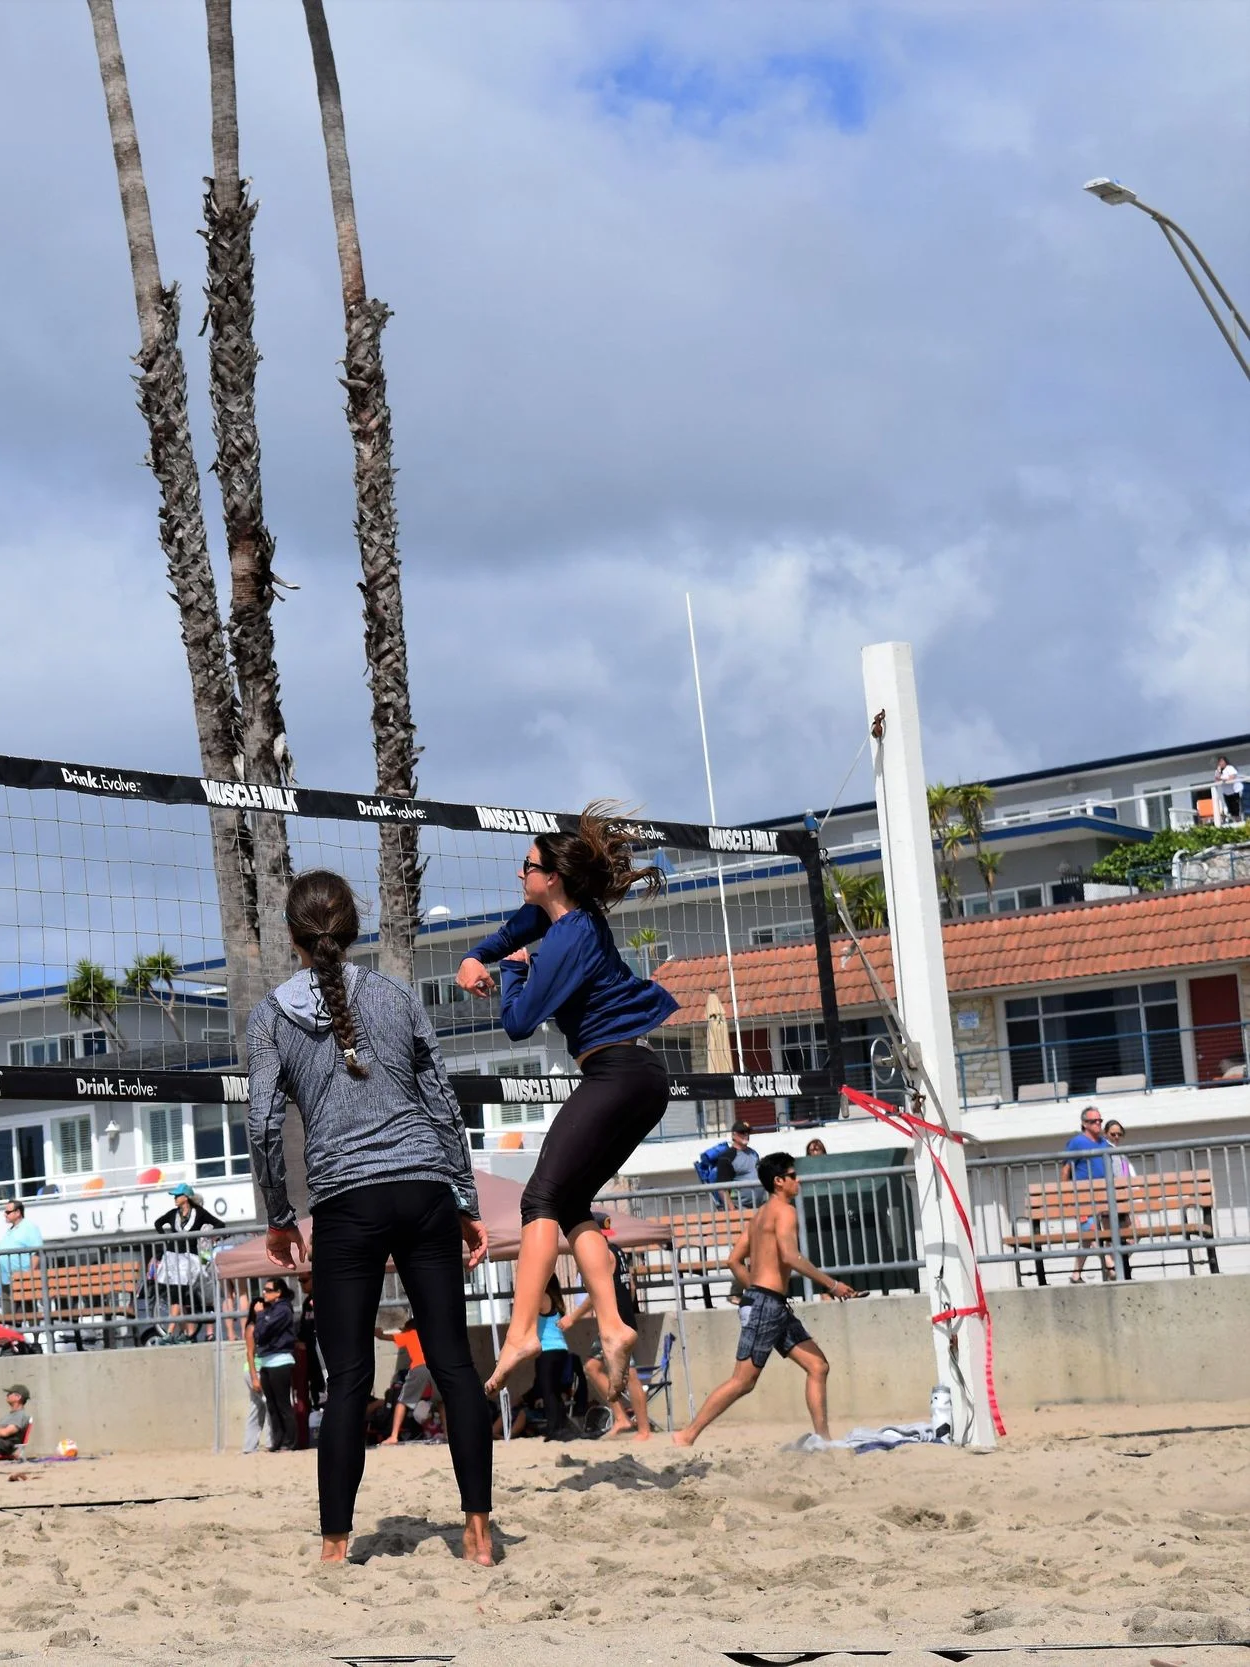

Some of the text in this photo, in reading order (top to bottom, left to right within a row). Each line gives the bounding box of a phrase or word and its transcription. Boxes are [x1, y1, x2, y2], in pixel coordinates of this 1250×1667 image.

[200, 779, 298, 812] MUSCLE MILK
[396, 803, 427, 819] volve.
[475, 806, 560, 833] MUSCLE MILK
[500, 1076, 551, 1102] MUSCLE
[668, 1080, 690, 1097] olve.
